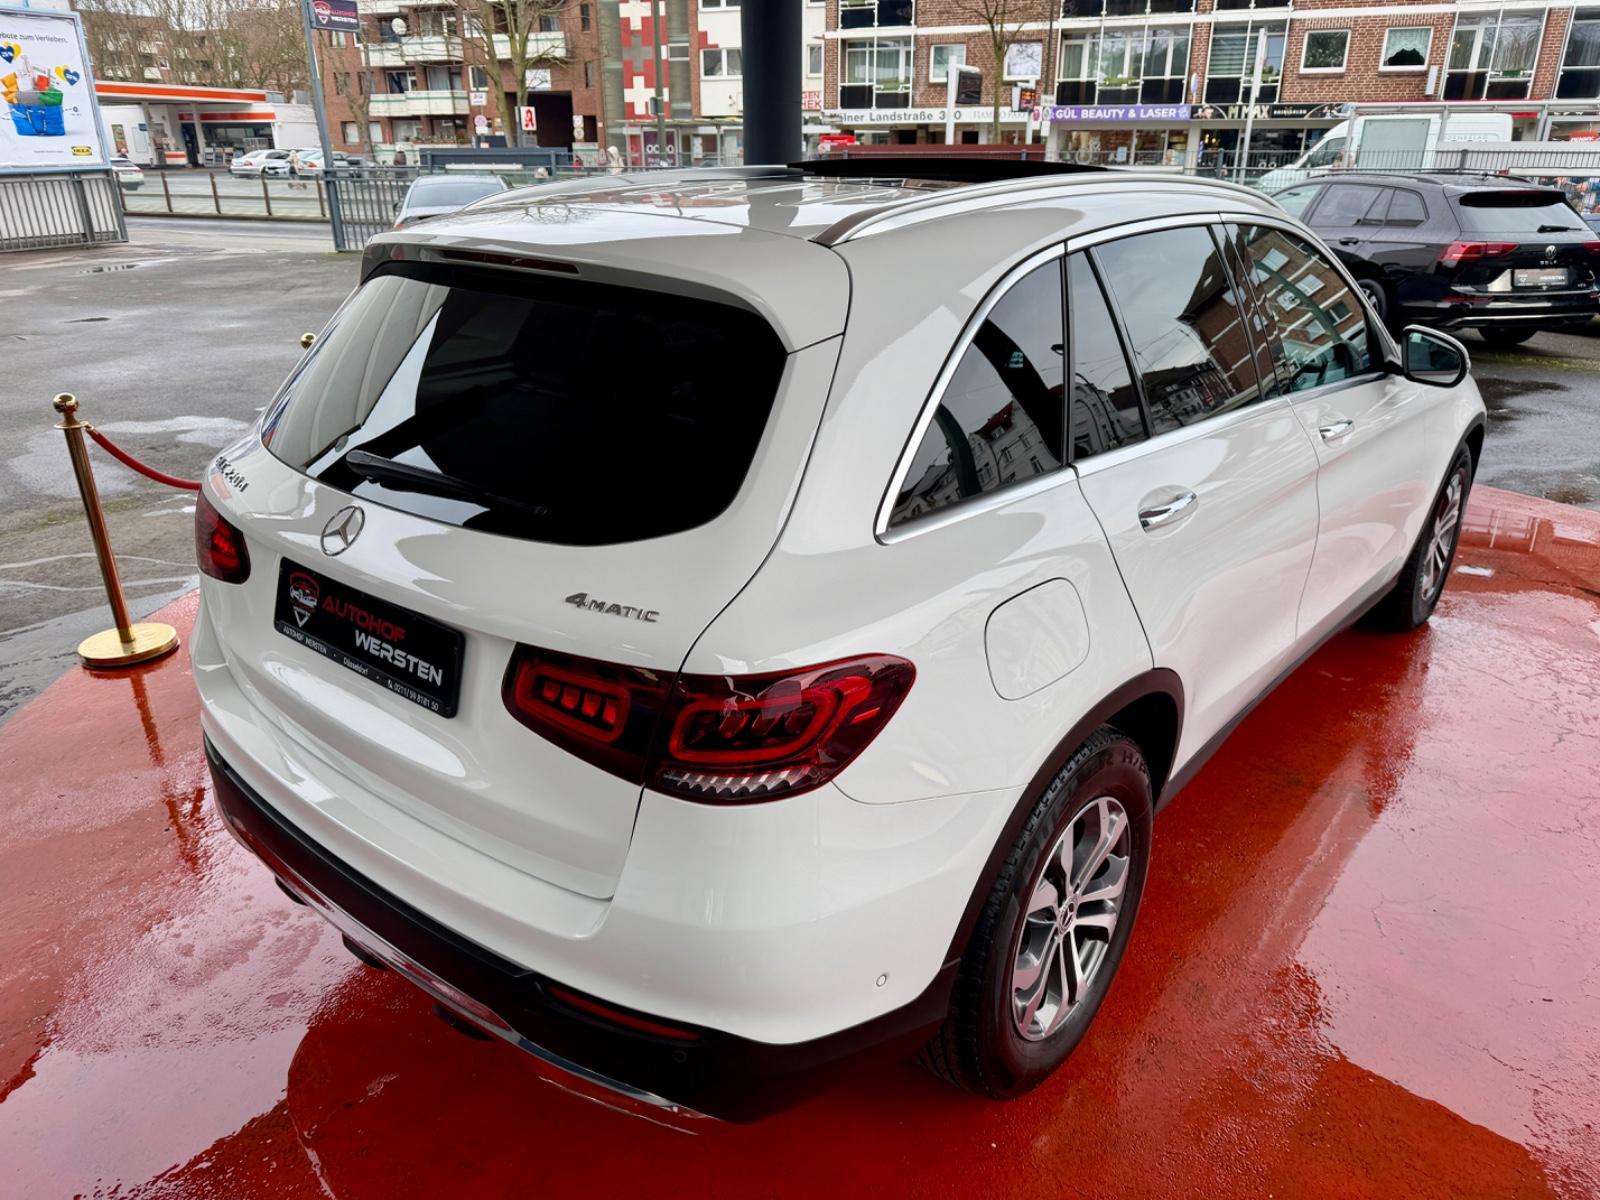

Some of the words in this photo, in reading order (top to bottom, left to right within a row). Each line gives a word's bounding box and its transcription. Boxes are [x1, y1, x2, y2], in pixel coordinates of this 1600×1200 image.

[869, 112, 933, 121] Landstraße
[938, 110, 962, 120] 30
[1055, 108, 1078, 119] GÜL
[1081, 108, 1125, 119] BEAUTY
[1127, 109, 1137, 118] &
[1140, 108, 1177, 119] LASER
[321, 594, 407, 641] AUTOHOF
[564, 592, 660, 623] 4MATIC
[282, 625, 305, 642] AUTOHOF
[304, 637, 327, 655] WERSTEN
[354, 628, 443, 687] WERSTEN
